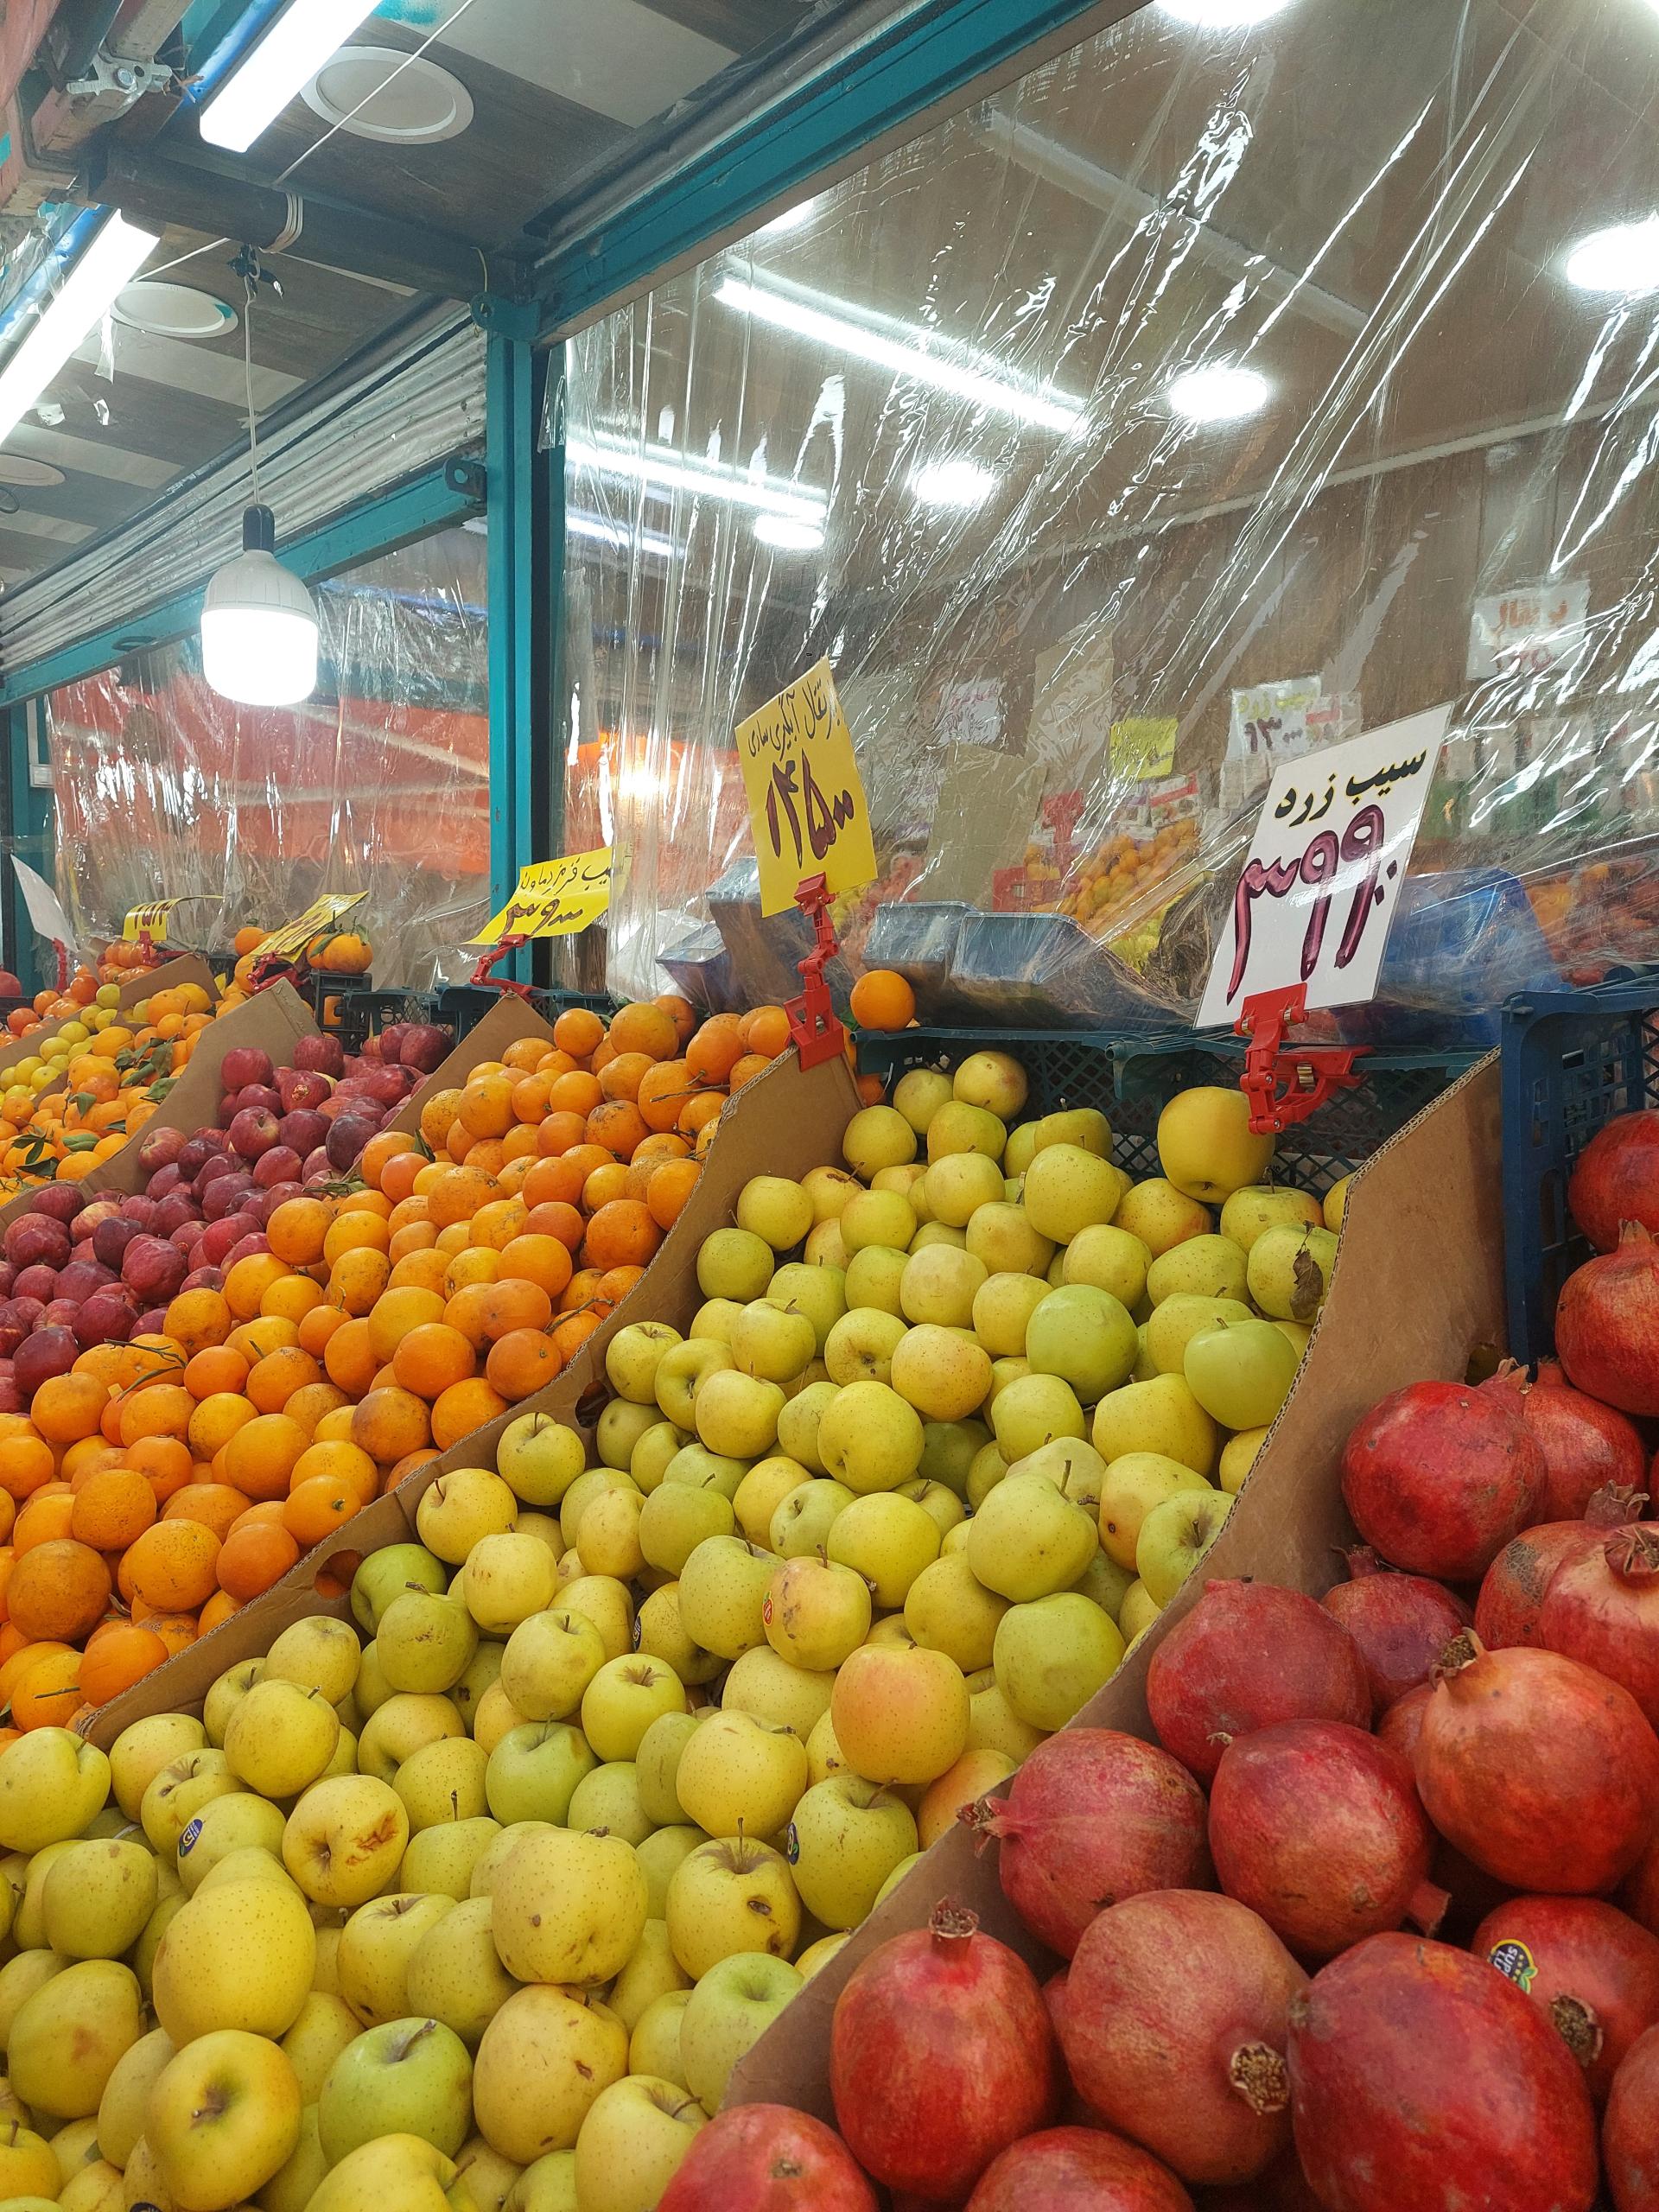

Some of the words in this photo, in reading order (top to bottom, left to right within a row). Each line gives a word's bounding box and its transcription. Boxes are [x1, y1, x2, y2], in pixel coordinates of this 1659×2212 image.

[1345, 750, 1427, 805] سیب
[1274, 773, 1337, 828] زرد
[541, 856, 581, 896] قرمز
[582, 864, 615, 891] یب
[1501, 1946, 1518, 1977] SUP
